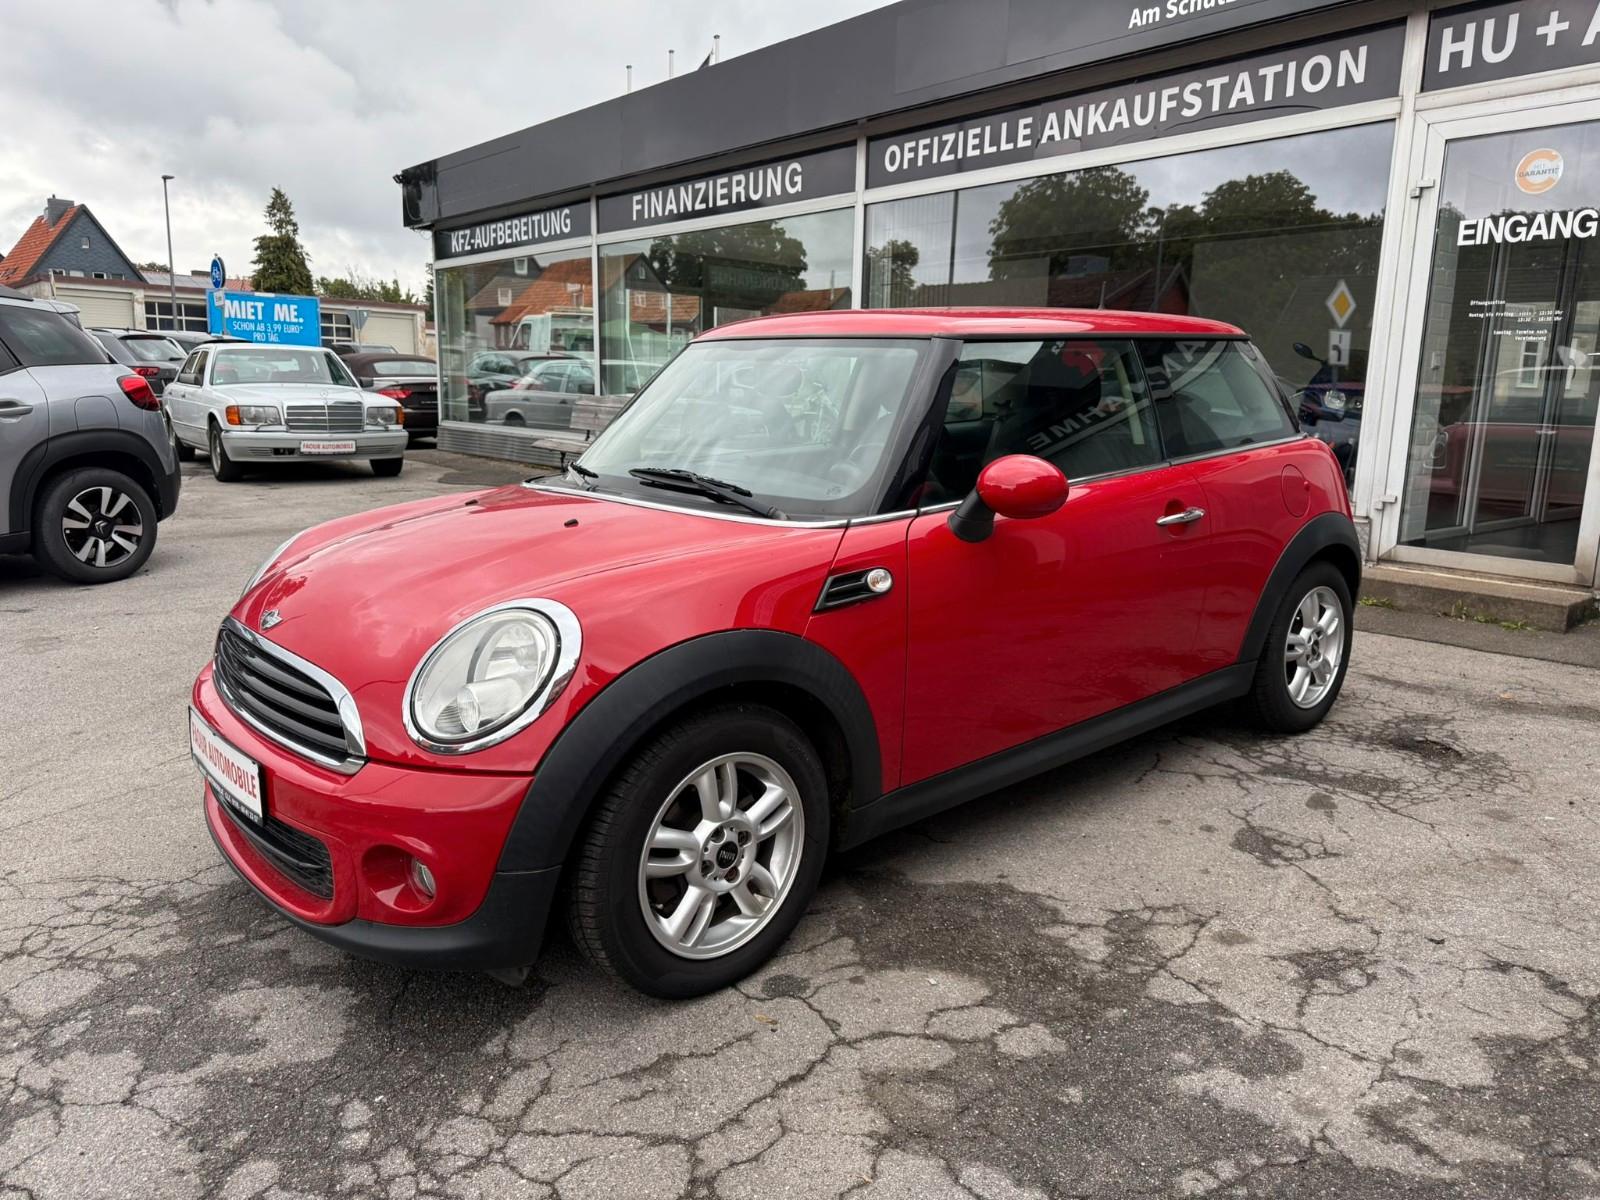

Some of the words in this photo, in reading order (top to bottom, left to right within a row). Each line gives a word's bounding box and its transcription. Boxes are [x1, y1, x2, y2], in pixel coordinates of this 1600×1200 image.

[1128, 6, 1160, 29] Am
[1439, 13, 1520, 72] HU
[884, 117, 1034, 172] OFFIZIELLE
[1040, 46, 1368, 143] ANKAUFSTATION
[632, 162, 803, 221] FINANZIERUNG
[451, 208, 571, 253] KFZ-AUFBEREITUNG
[1457, 209, 1599, 246] EINGANG
[224, 300, 264, 320] MIET
[273, 303, 304, 323] ME.
[232, 321, 255, 331] SCHON
[256, 322, 265, 331] AB
[253, 332, 266, 341] PRO
[208, 741, 257, 800] AUTOMOBILE
